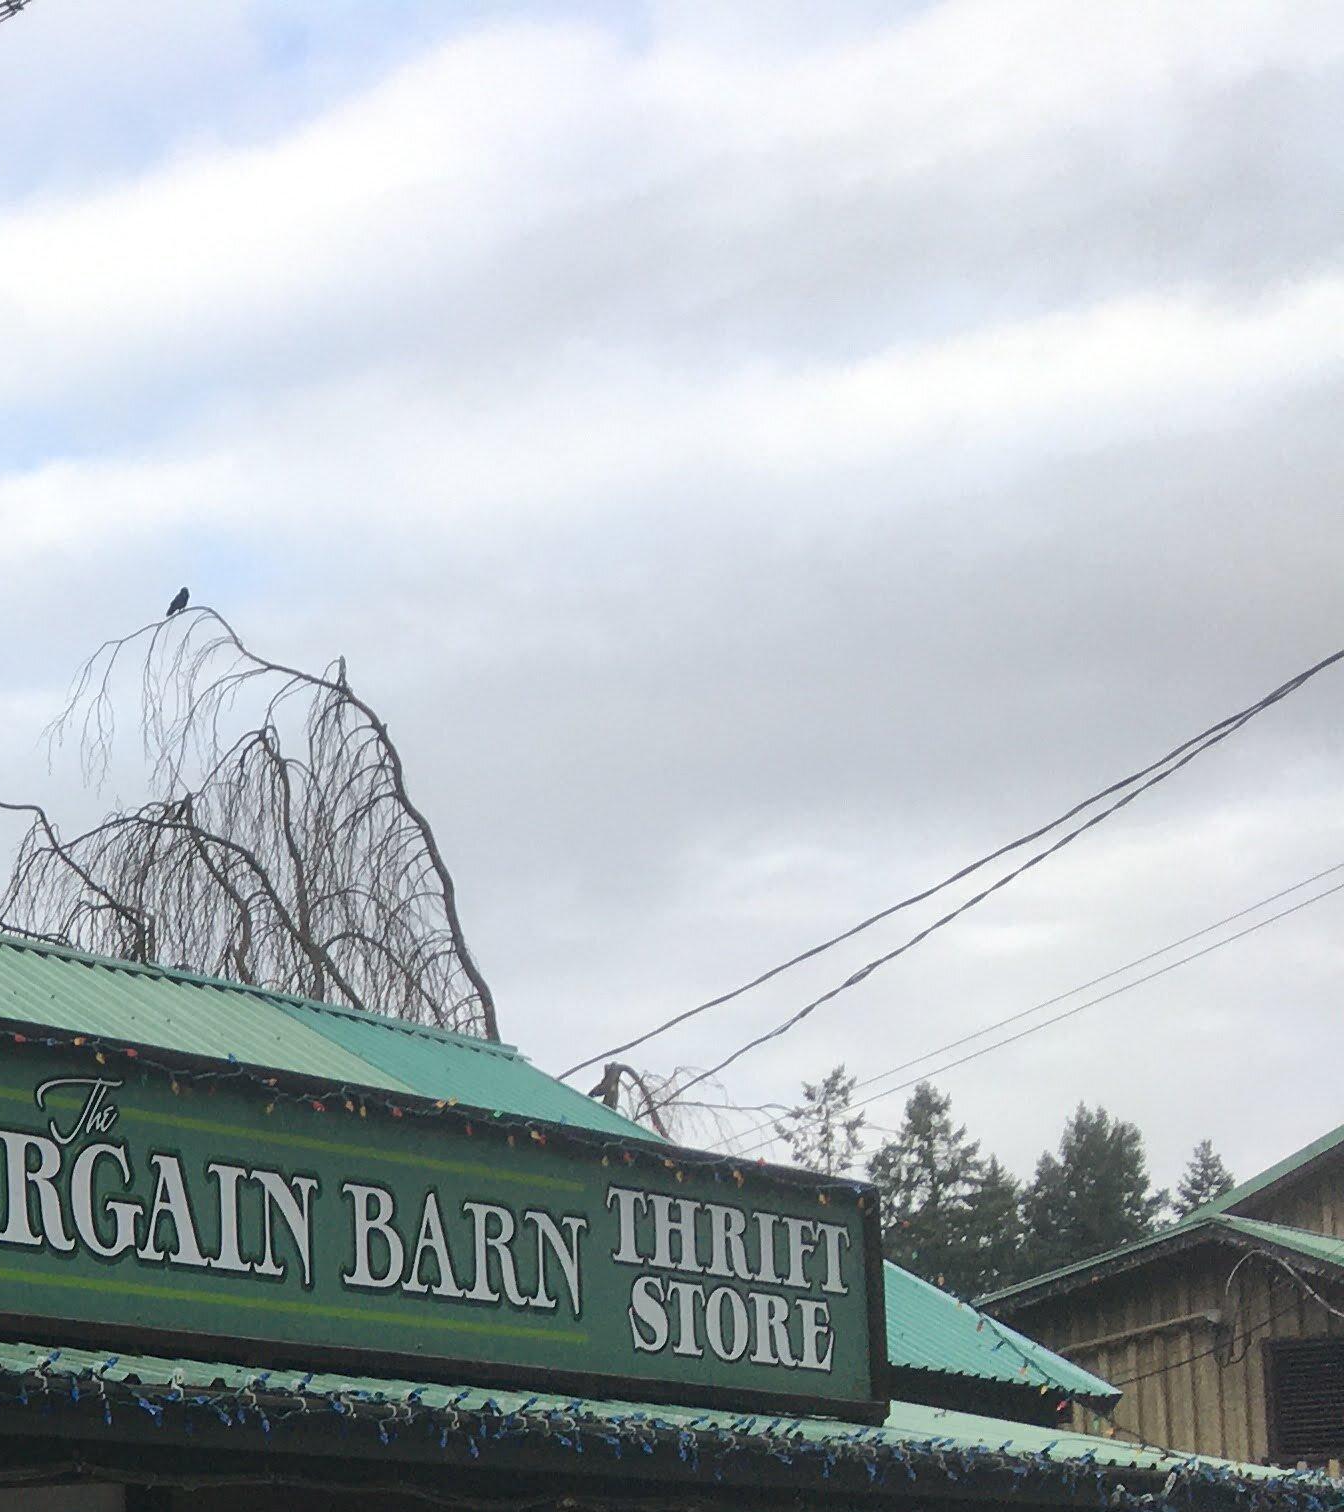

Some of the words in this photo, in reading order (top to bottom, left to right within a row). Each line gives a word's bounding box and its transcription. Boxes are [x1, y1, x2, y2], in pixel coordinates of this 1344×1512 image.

[35, 1076, 124, 1146] The
[342, 1183, 589, 1315] BARN
[606, 1186, 850, 1295] THRIFT
[628, 1275, 835, 1372] STORE
